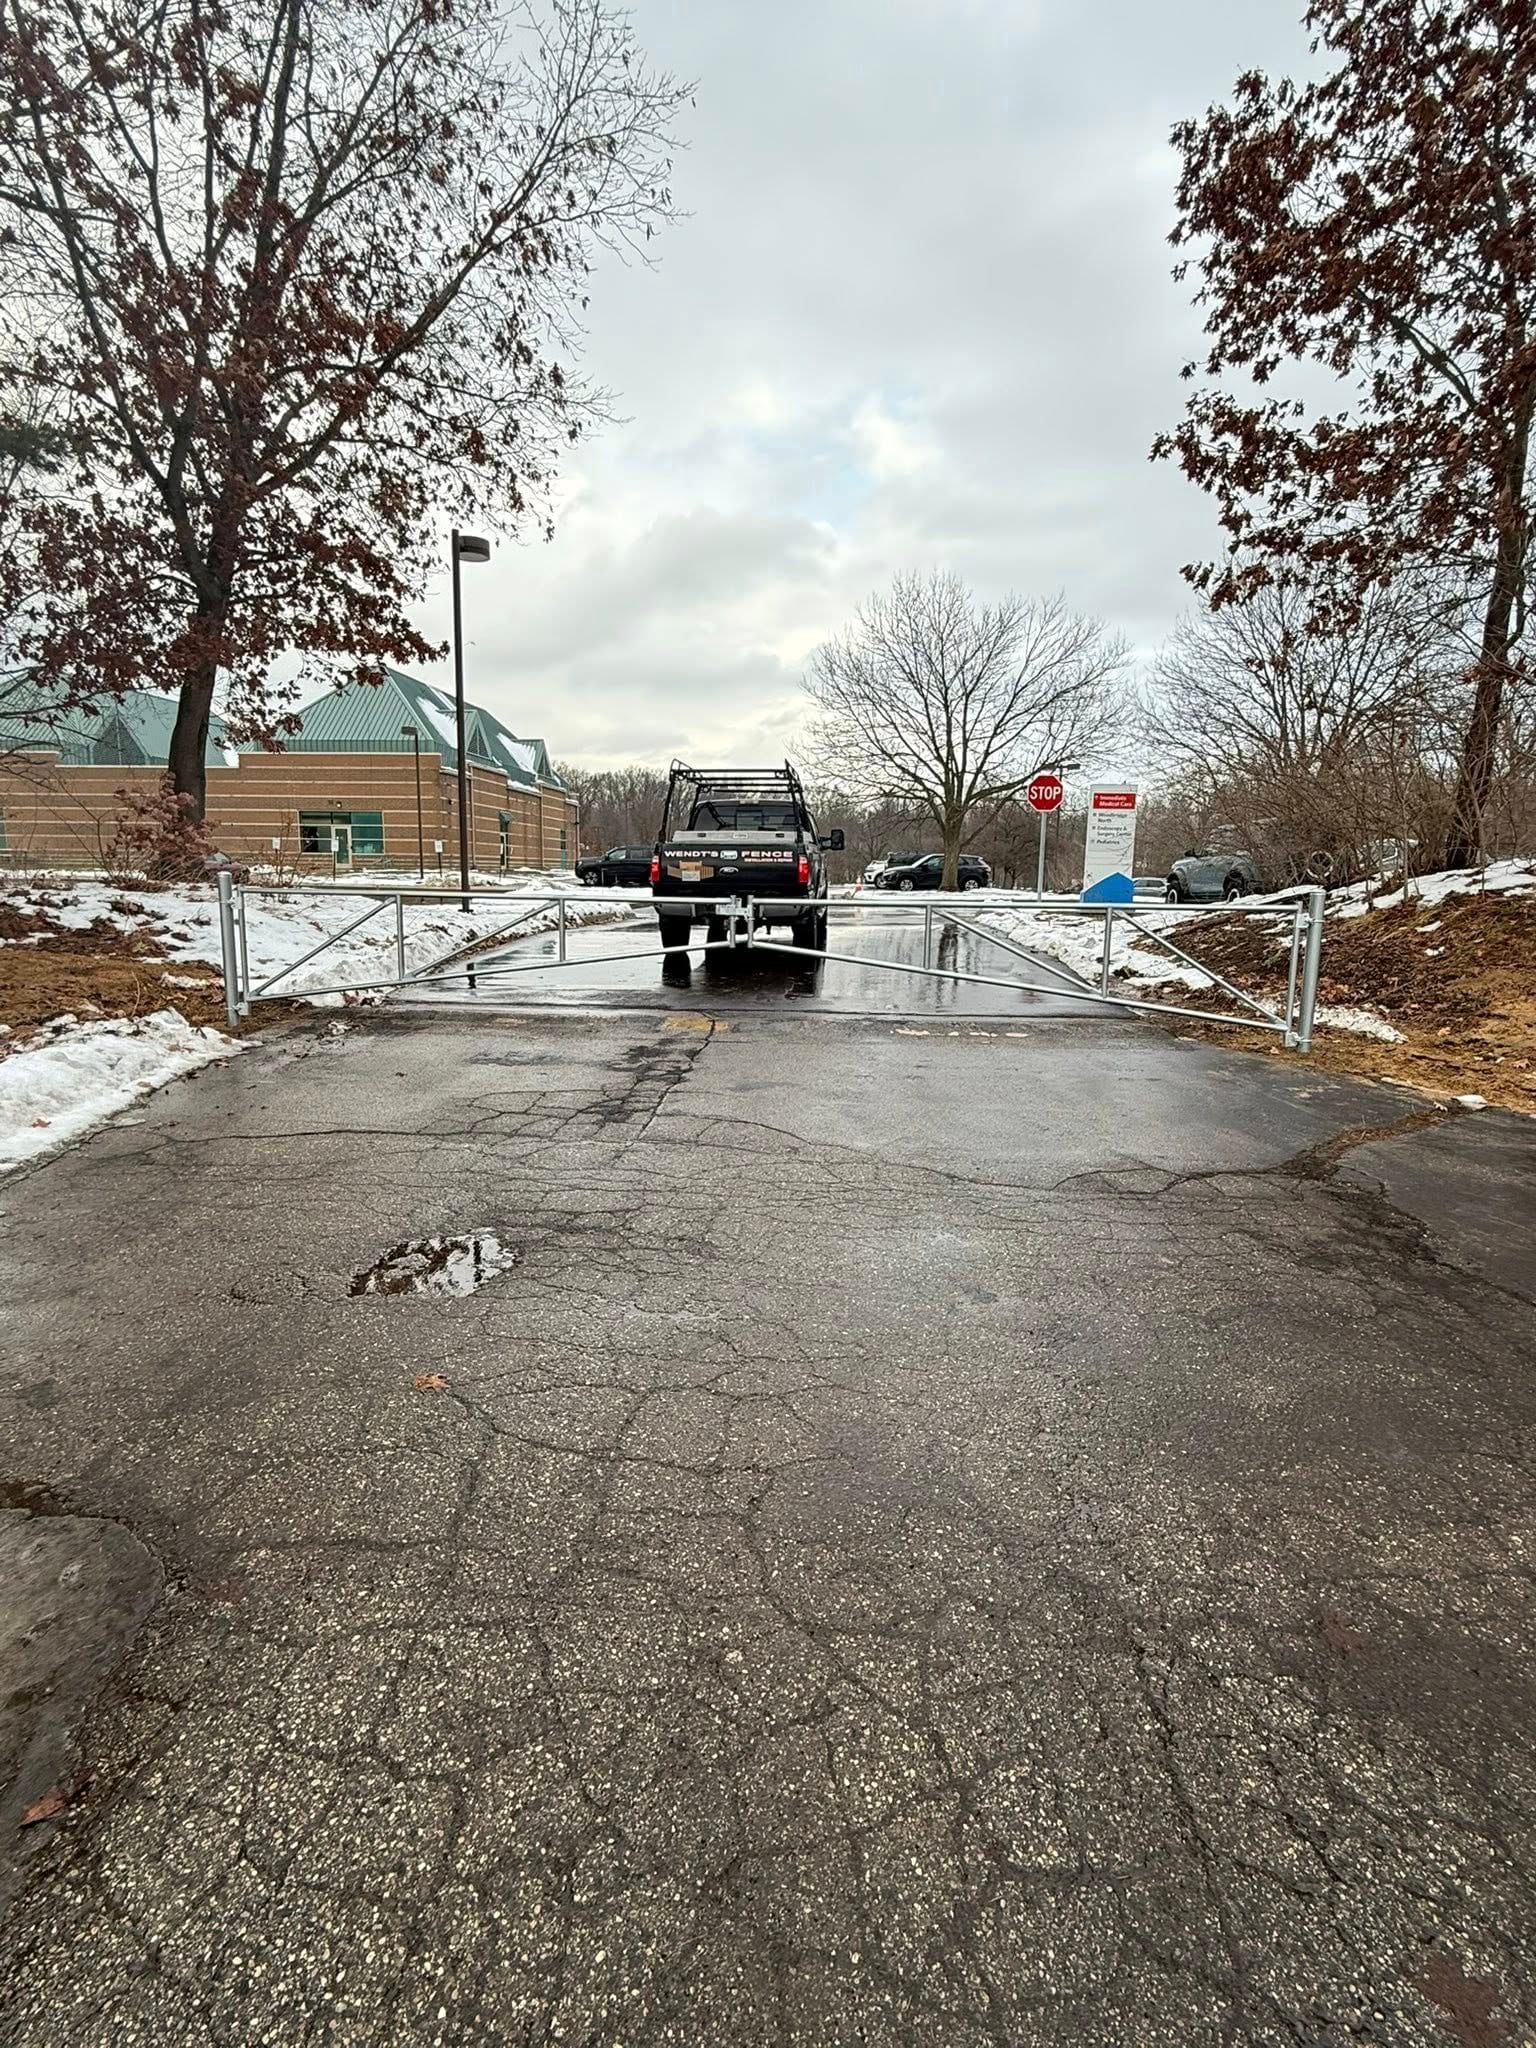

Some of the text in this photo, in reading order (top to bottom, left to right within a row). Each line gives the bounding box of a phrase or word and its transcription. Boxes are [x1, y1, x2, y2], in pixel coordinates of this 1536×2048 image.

[1030, 786, 1061, 800] STOP
[664, 850, 719, 858] WENDT'S
[741, 850, 793, 858] FENCE
